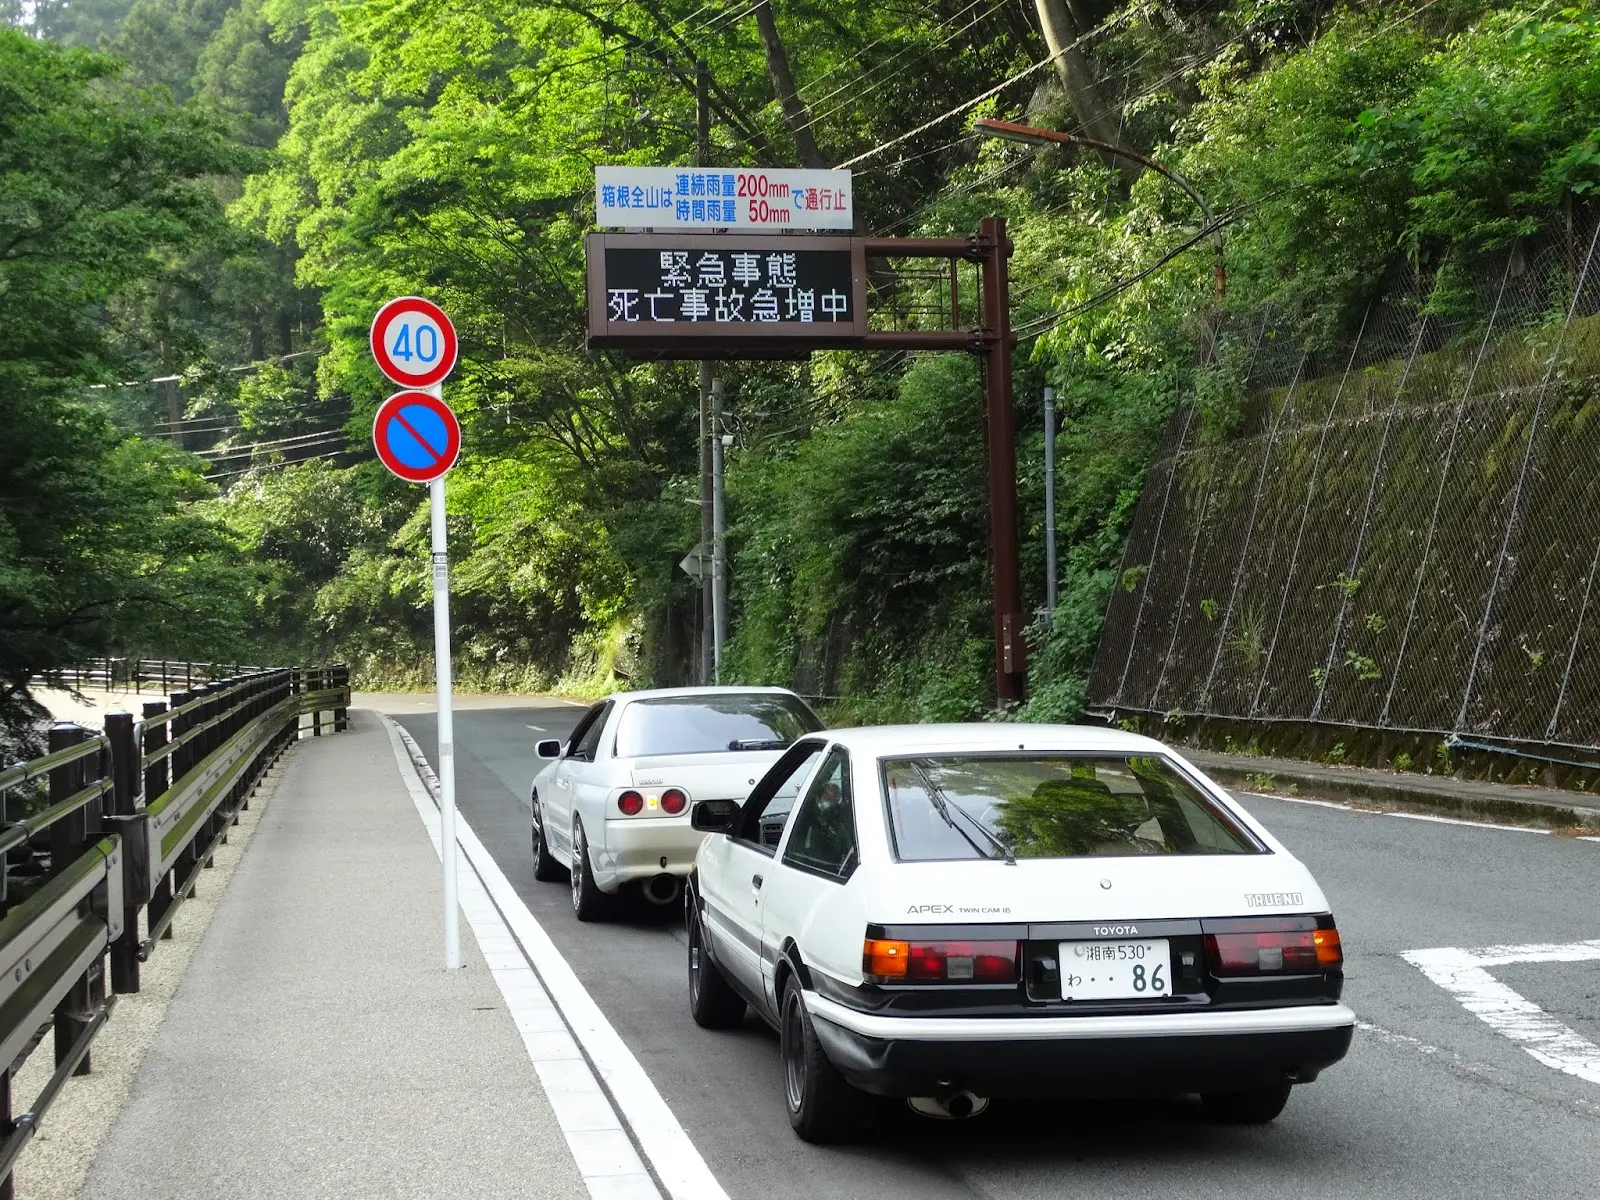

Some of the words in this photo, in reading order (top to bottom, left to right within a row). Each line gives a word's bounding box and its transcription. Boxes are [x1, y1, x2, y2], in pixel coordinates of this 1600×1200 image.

[602, 185, 673, 209] 箱根全山は
[737, 174, 789, 198] 200mm
[676, 199, 737, 222] 時間雨量
[749, 199, 790, 223] 50mm
[660, 252, 797, 288] 緊急事態
[608, 287, 847, 323] 死亡事故急増中
[392, 324, 438, 363] 40
[907, 905, 954, 914] APEX
[1244, 892, 1303, 907] TRUENO
[1093, 926, 1138, 935] TOYOTA
[1133, 963, 1165, 992] 86
